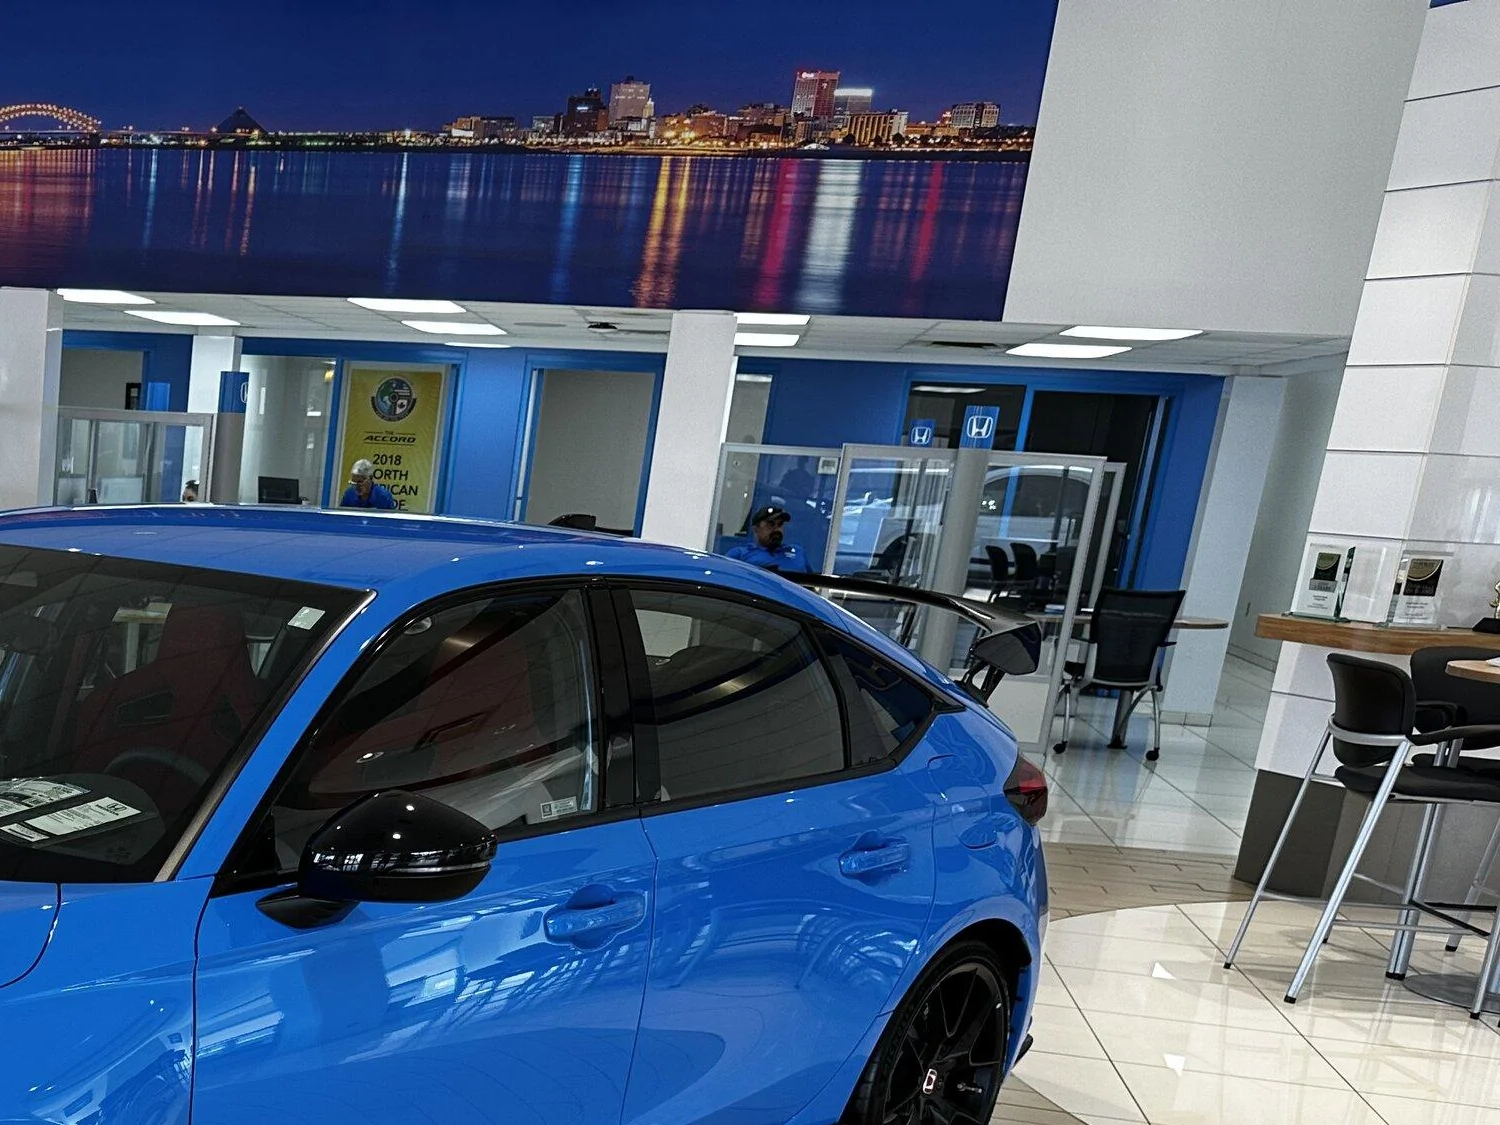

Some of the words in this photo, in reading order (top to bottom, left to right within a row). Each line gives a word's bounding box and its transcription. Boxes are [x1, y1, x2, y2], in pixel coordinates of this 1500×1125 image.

[364, 435, 416, 443] ACCORD
[373, 454, 402, 466] 2018
[373, 469, 409, 481] ORTH
